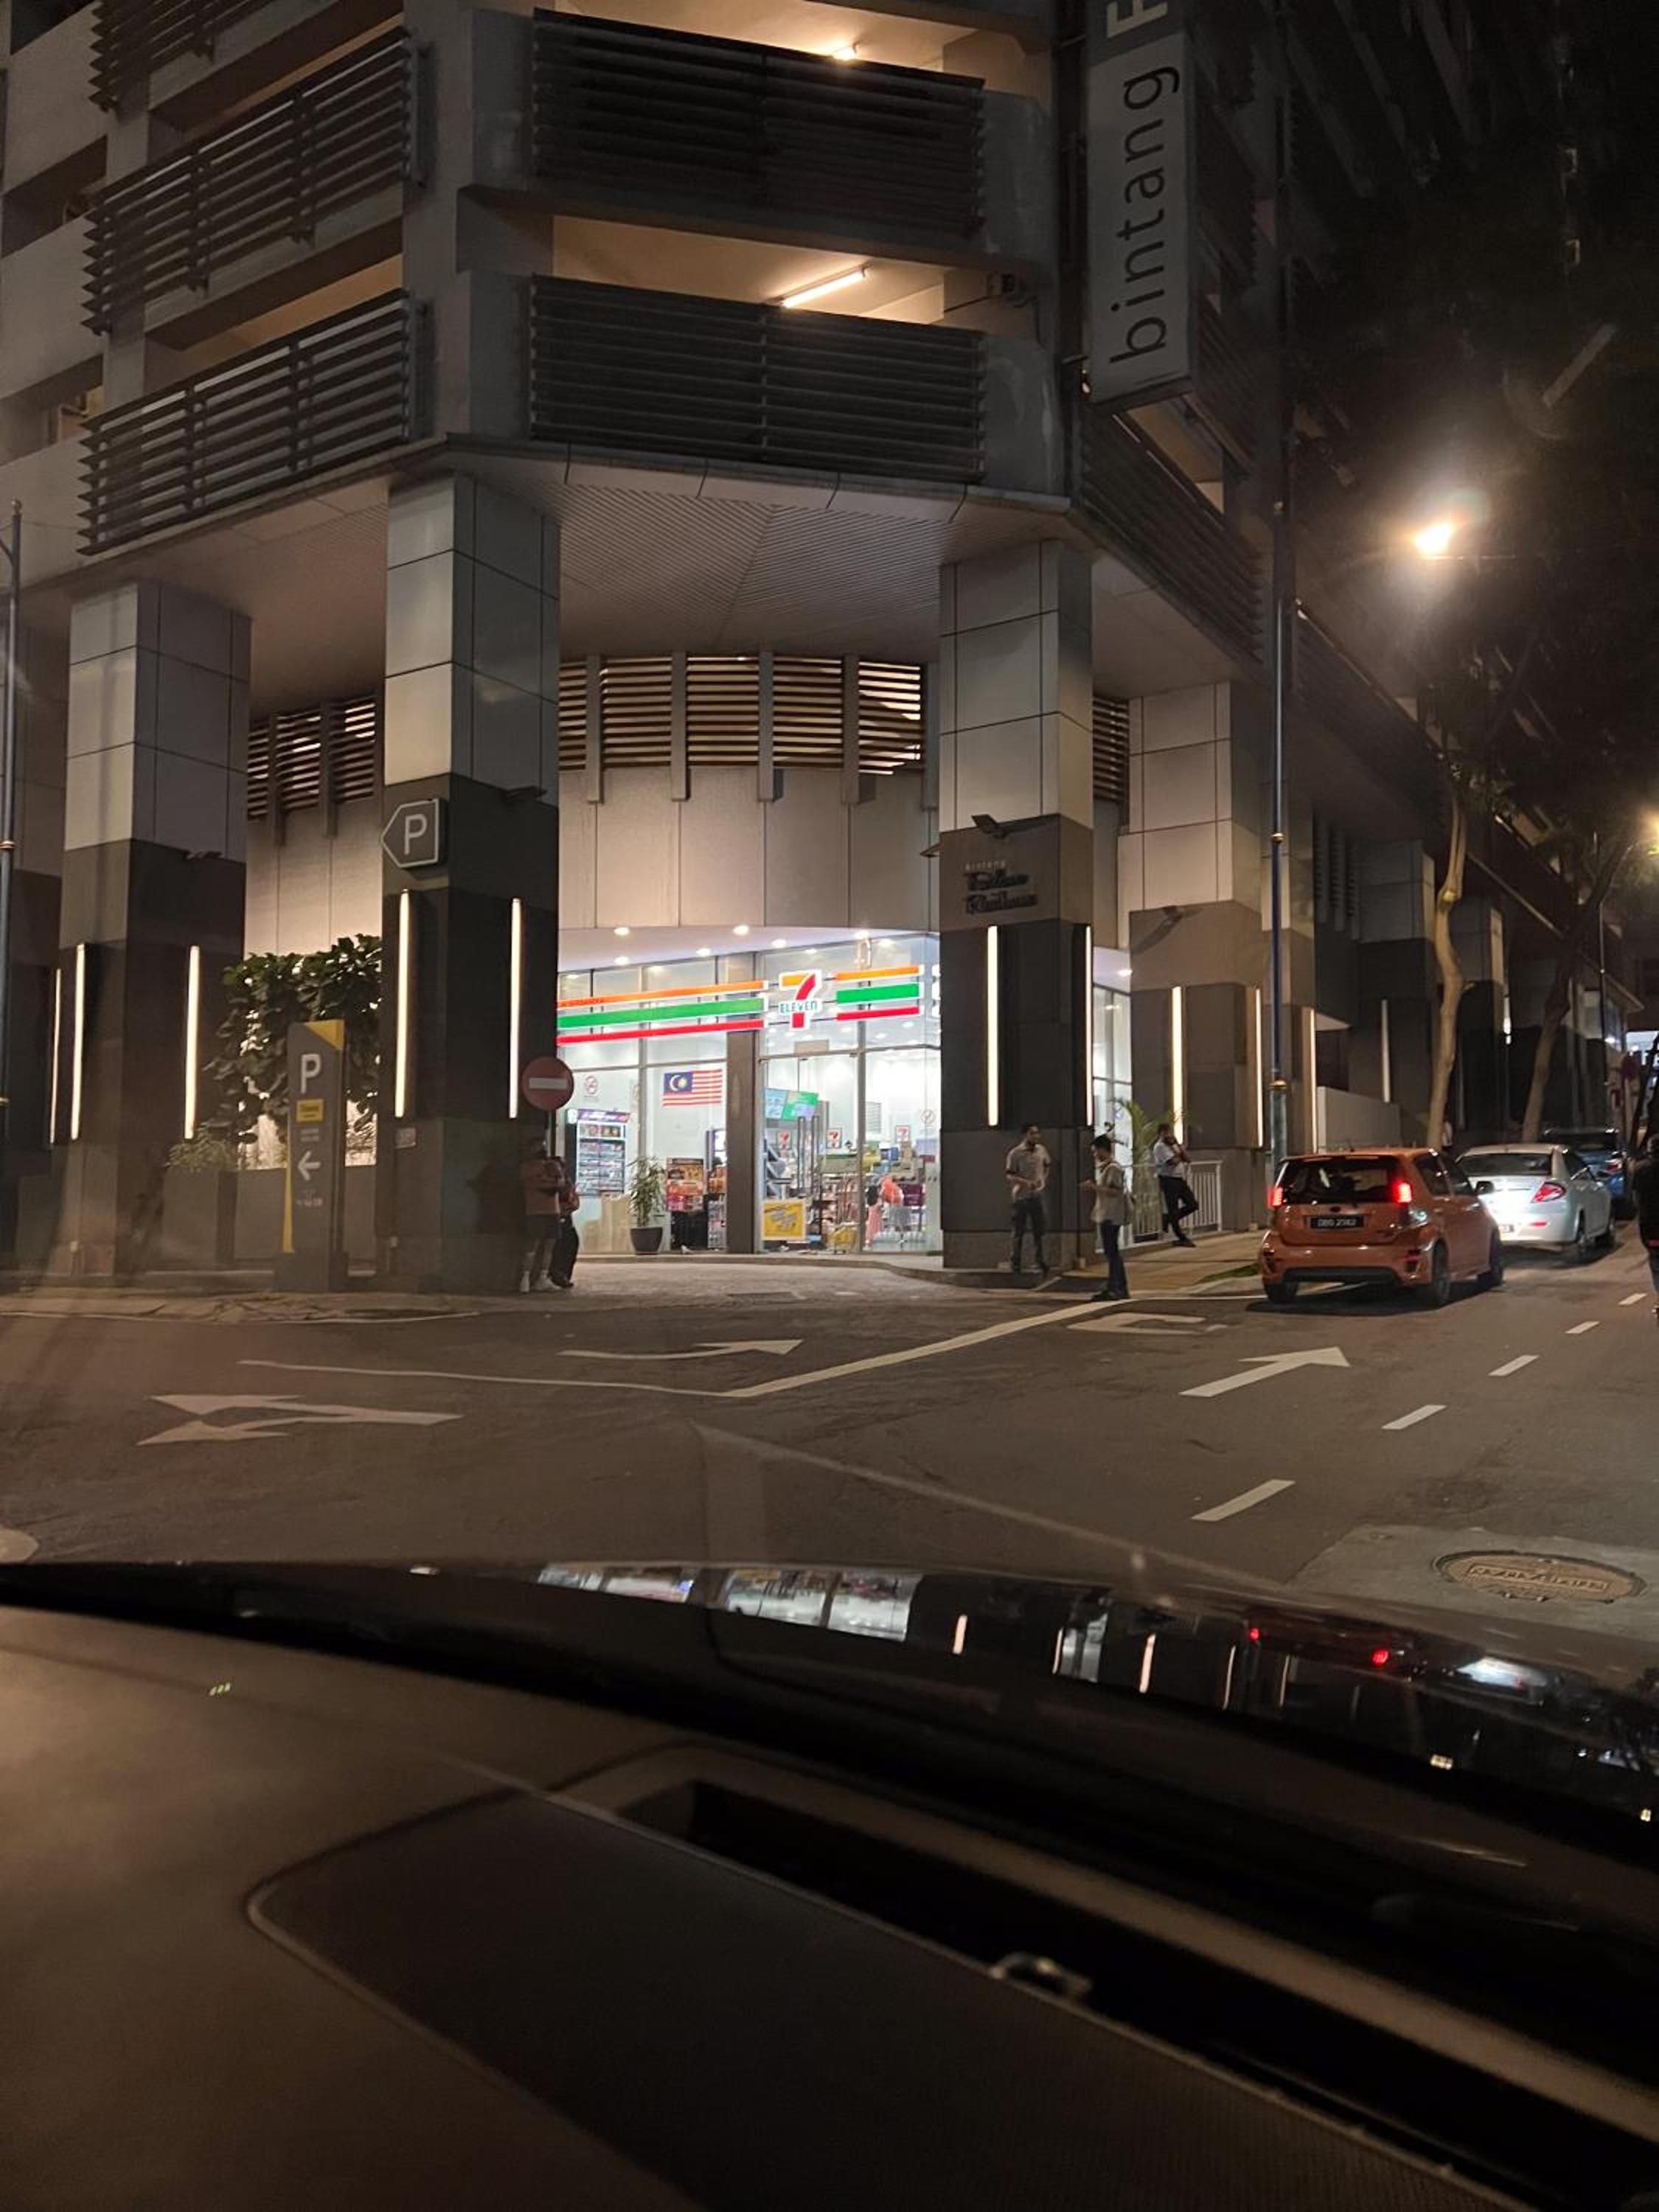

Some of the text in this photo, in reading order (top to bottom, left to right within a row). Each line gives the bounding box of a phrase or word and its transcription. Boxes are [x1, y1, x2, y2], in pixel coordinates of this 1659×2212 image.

[1108, 66, 1180, 364] bintang
[404, 813, 428, 855] P
[300, 1053, 322, 1094] P
